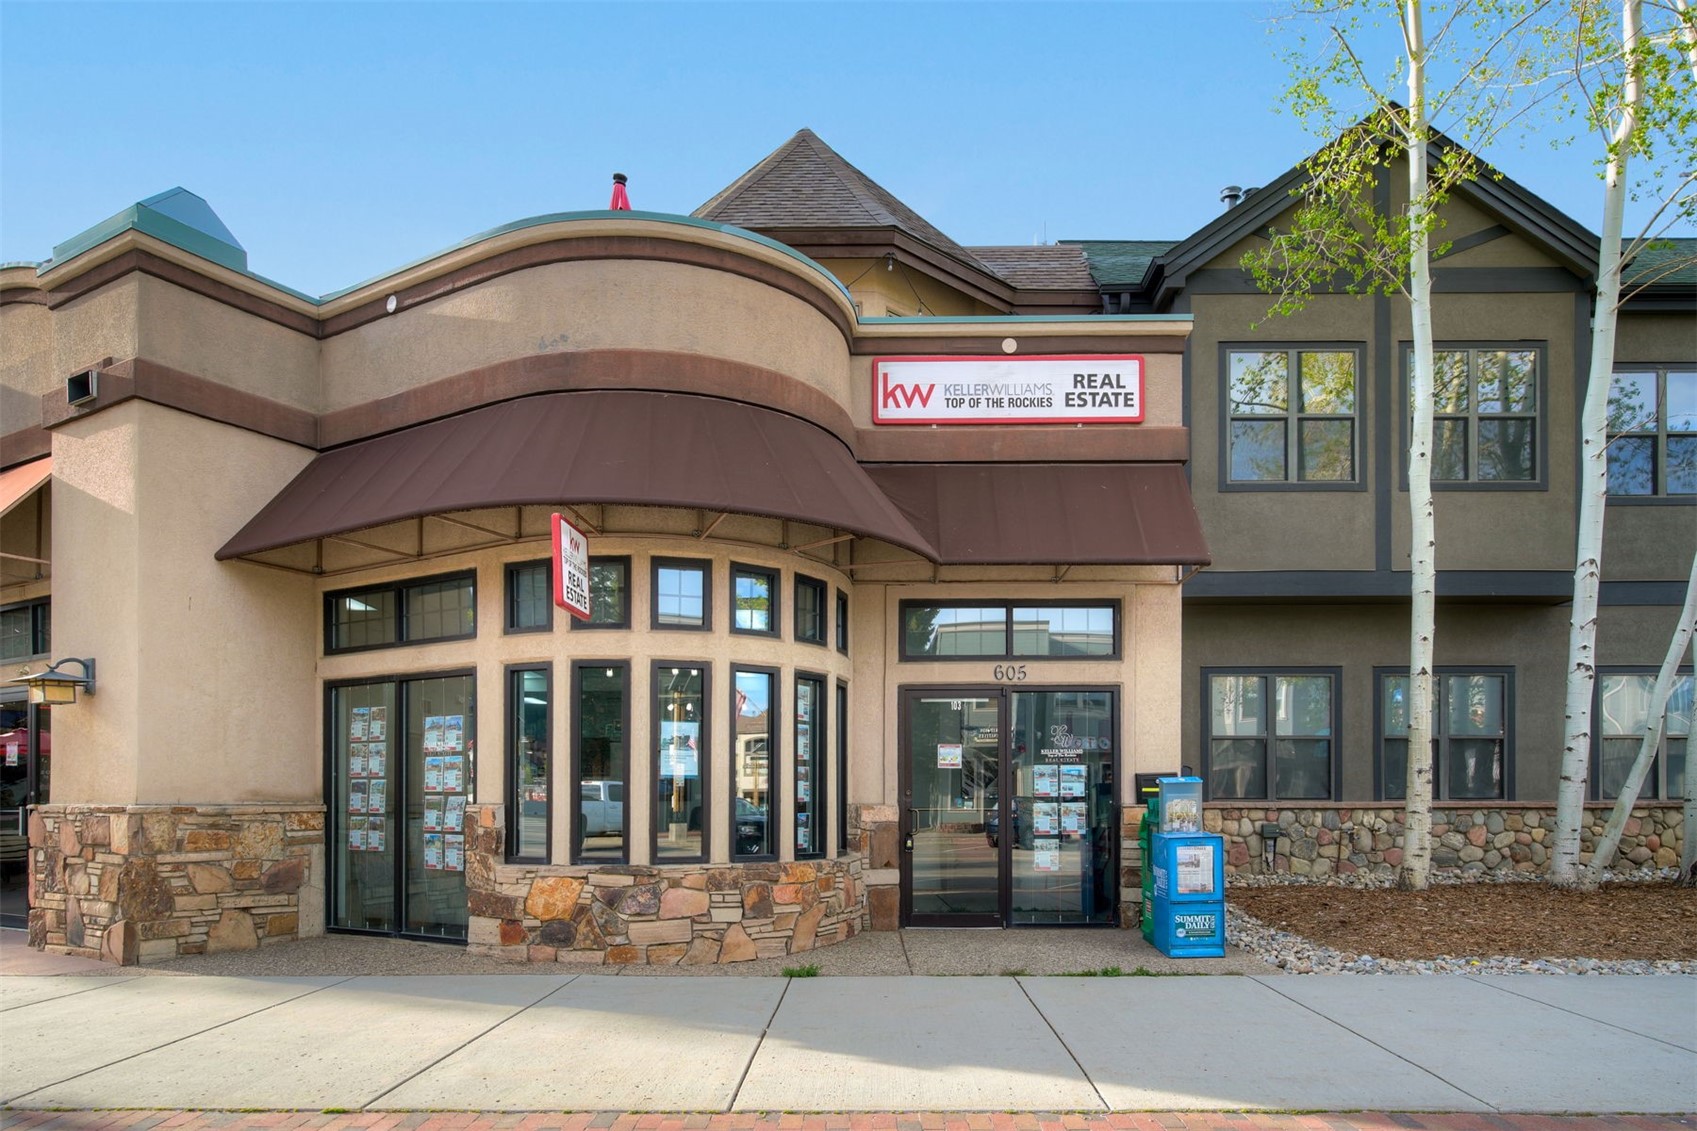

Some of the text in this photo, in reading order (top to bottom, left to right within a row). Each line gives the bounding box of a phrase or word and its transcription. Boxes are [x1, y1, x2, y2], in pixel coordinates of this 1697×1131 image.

[1073, 374, 1126, 389] REAL
[882, 372, 936, 408] kw
[945, 397, 1053, 408] TOP OF THE ROCKIES
[1065, 392, 1135, 408] ESTATE
[568, 571, 585, 593] REAL
[566, 585, 588, 610] ESTATE
[993, 664, 1027, 681] 605
[951, 700, 962, 710] 103
[1175, 914, 1211, 923] SUMMIT
